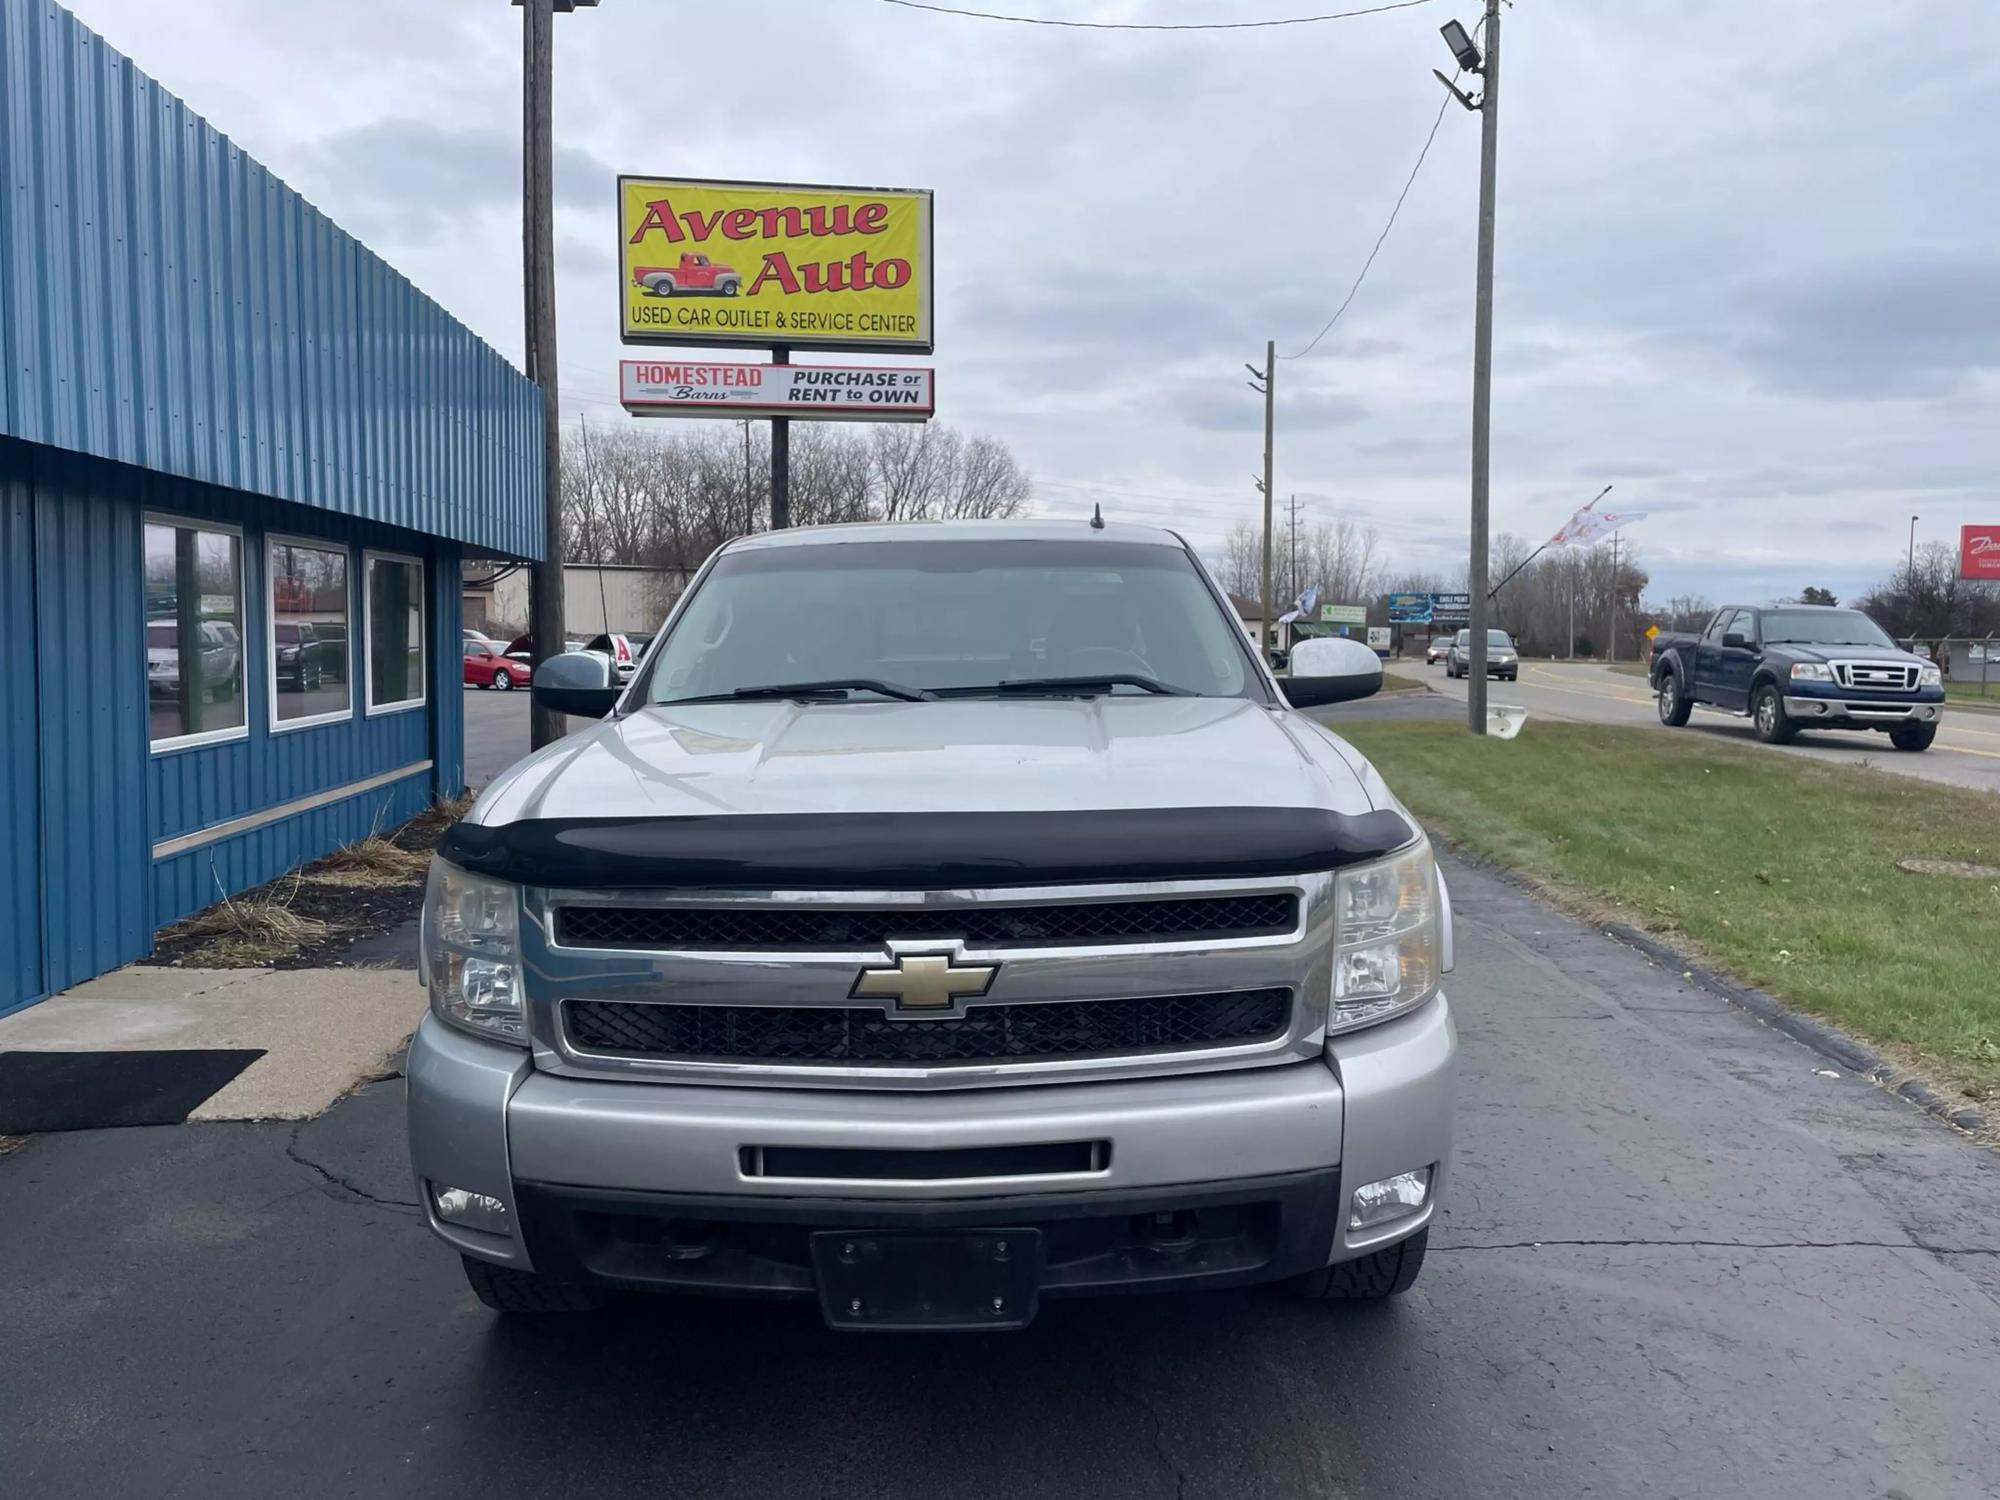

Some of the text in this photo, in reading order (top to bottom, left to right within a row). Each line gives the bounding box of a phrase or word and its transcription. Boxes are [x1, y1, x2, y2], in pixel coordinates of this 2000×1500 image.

[629, 199, 889, 244] Avenue
[746, 250, 912, 296] Auto
[632, 306, 916, 332] USED CAR OUTLET & SERVICE CENTER
[636, 365, 762, 387] HOMESTEAD
[793, 371, 921, 387] PURCHASE or
[668, 385, 729, 400] Barns
[788, 387, 919, 404] RENT to OWN
[616, 636, 631, 661] A
